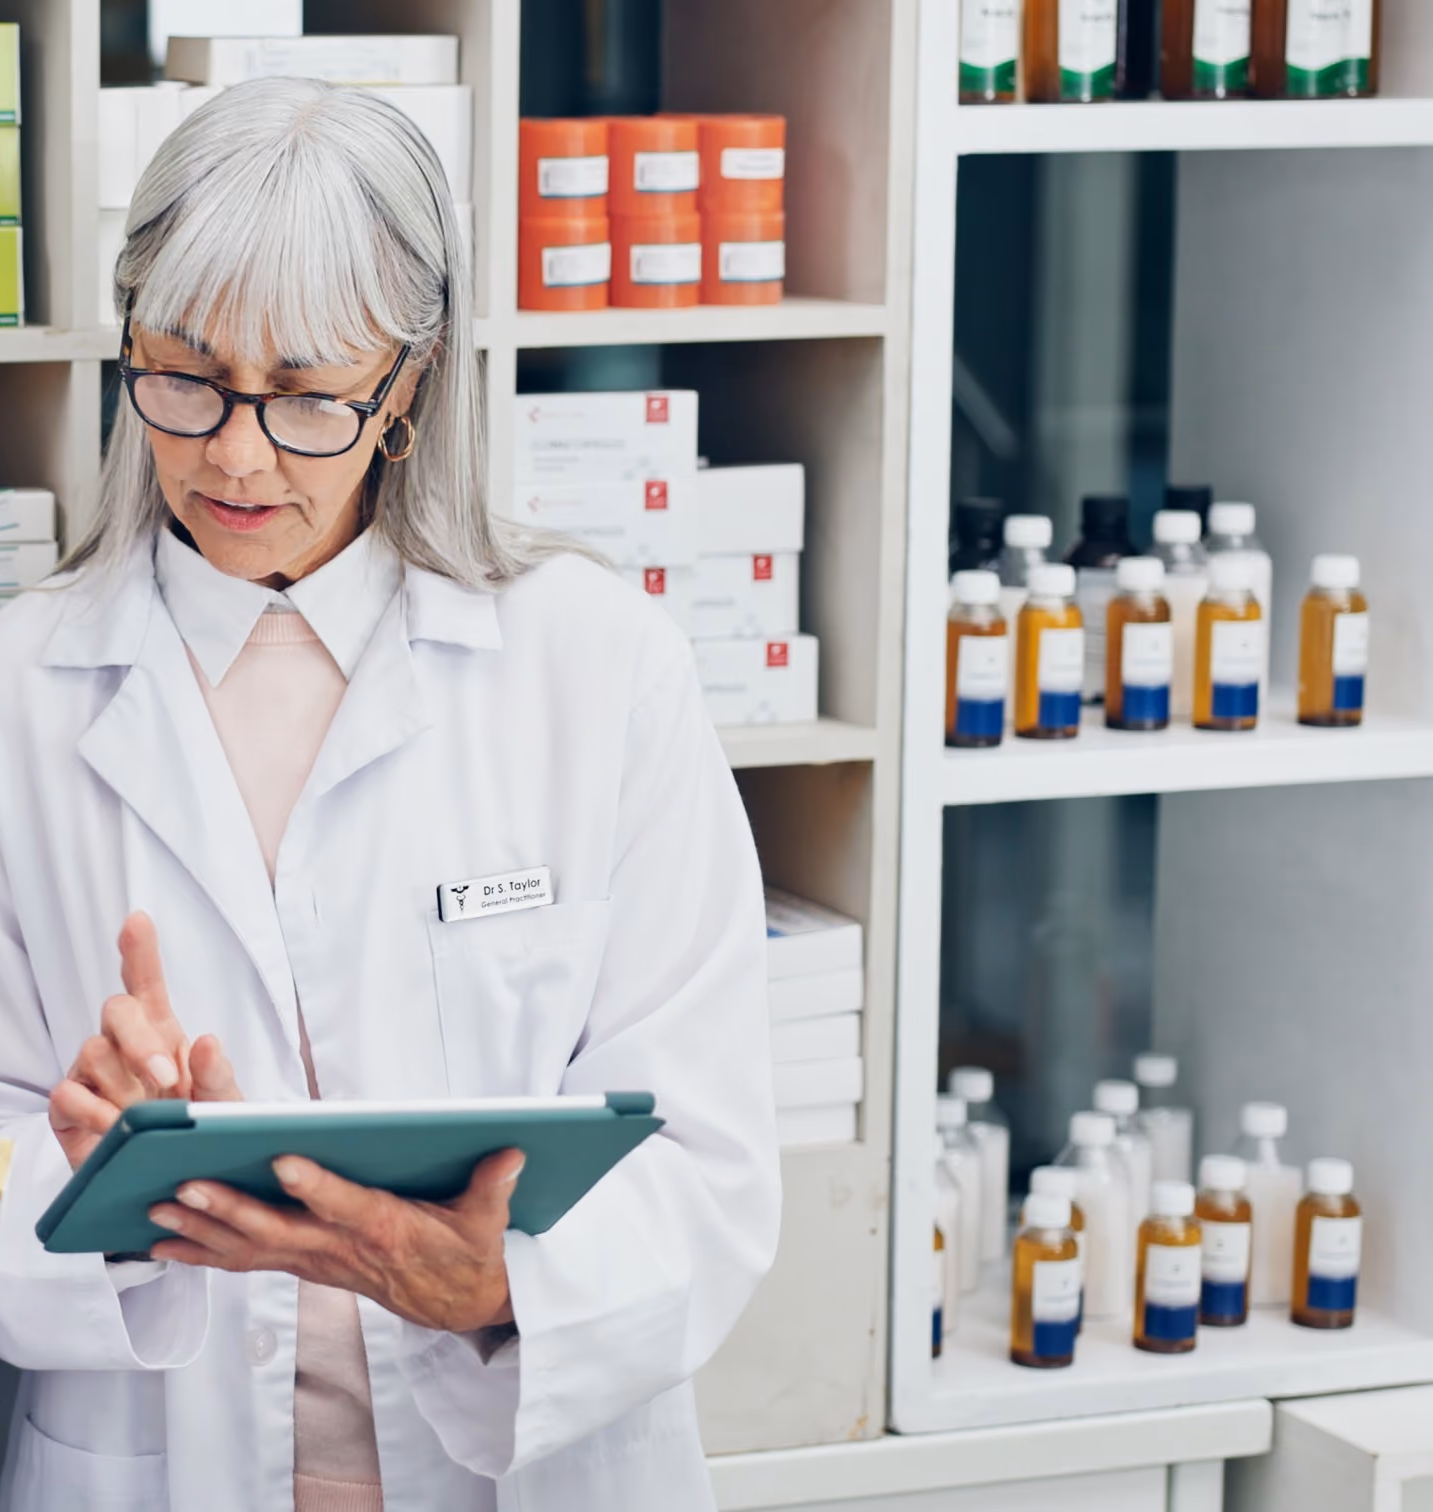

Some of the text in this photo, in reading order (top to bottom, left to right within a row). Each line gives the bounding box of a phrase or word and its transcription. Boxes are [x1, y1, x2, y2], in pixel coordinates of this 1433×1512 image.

[483, 878, 541, 896] Dr S. Taylor
[481, 892, 546, 908] General Practitioner
